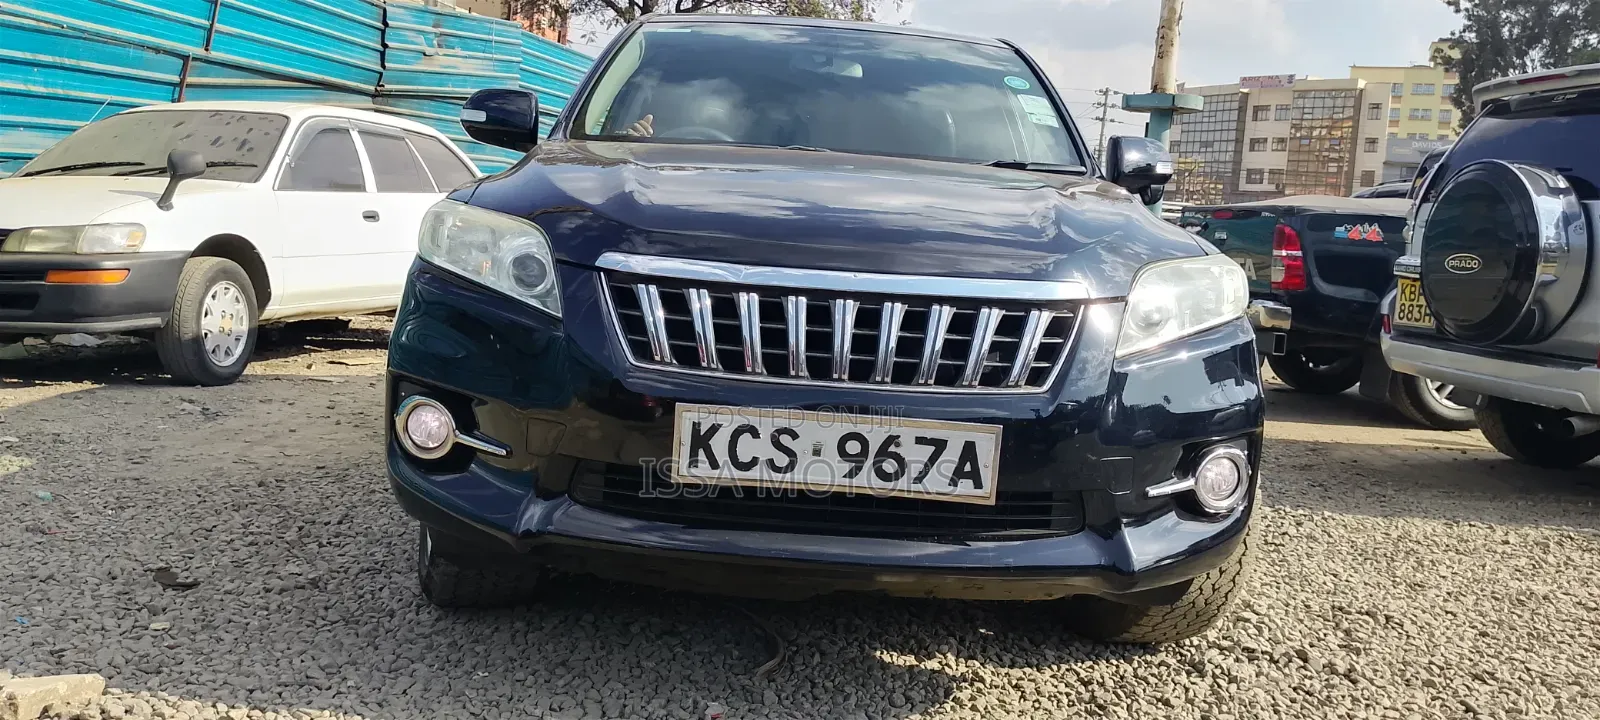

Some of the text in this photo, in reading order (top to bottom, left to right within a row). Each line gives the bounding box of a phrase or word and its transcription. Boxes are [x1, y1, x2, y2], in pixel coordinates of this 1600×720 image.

[1448, 260, 1479, 268] PRADO
[688, 421, 984, 490] KCS 967A
